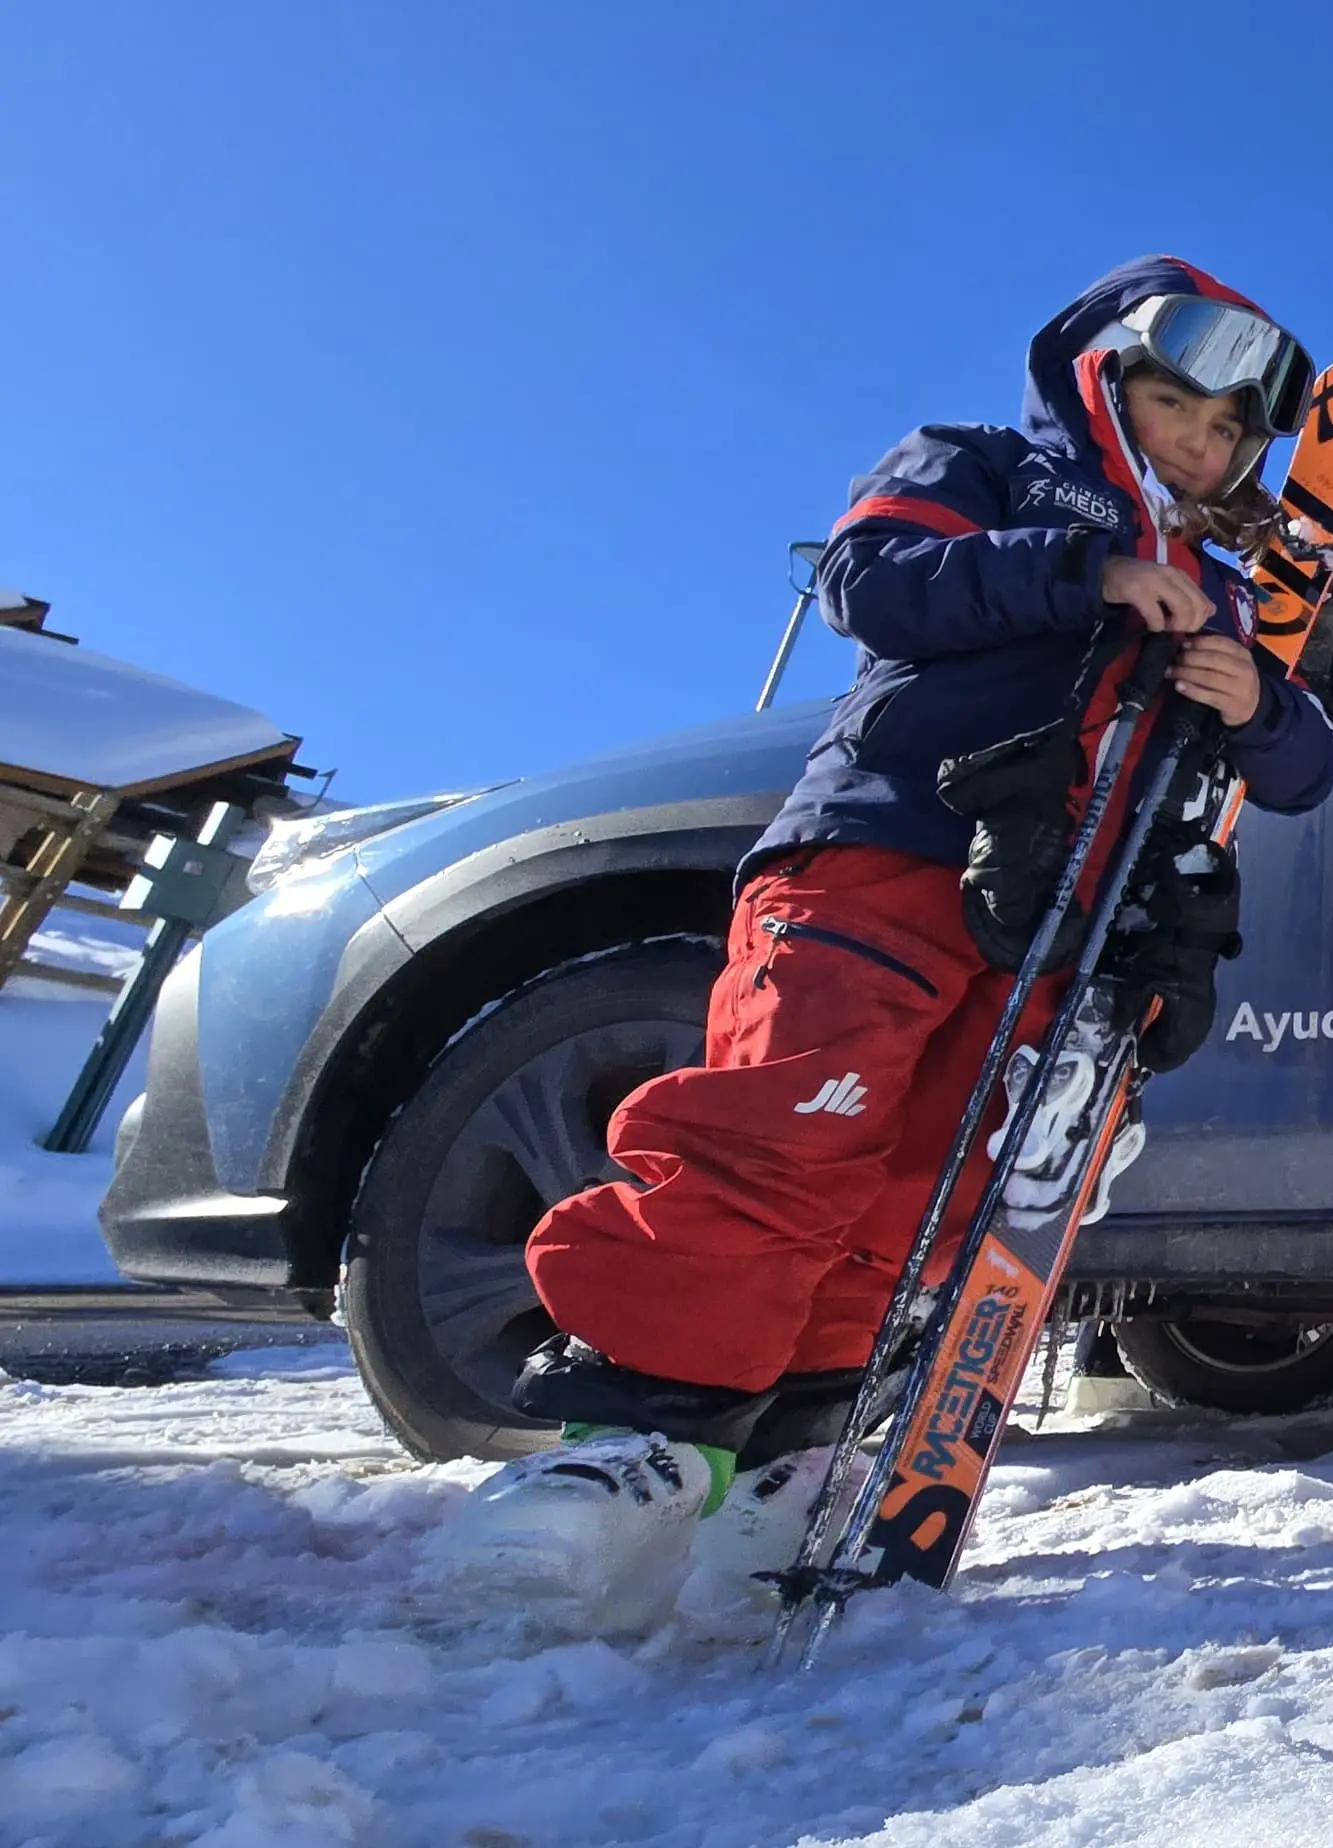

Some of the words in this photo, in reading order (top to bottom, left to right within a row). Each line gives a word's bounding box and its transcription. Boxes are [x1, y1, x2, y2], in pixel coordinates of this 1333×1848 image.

[1055, 487, 1119, 524] MEDS
[911, 1294, 1011, 1480] RACETIGER
[970, 1401, 992, 1439] WORLD
[985, 1413, 998, 1435] CUP
